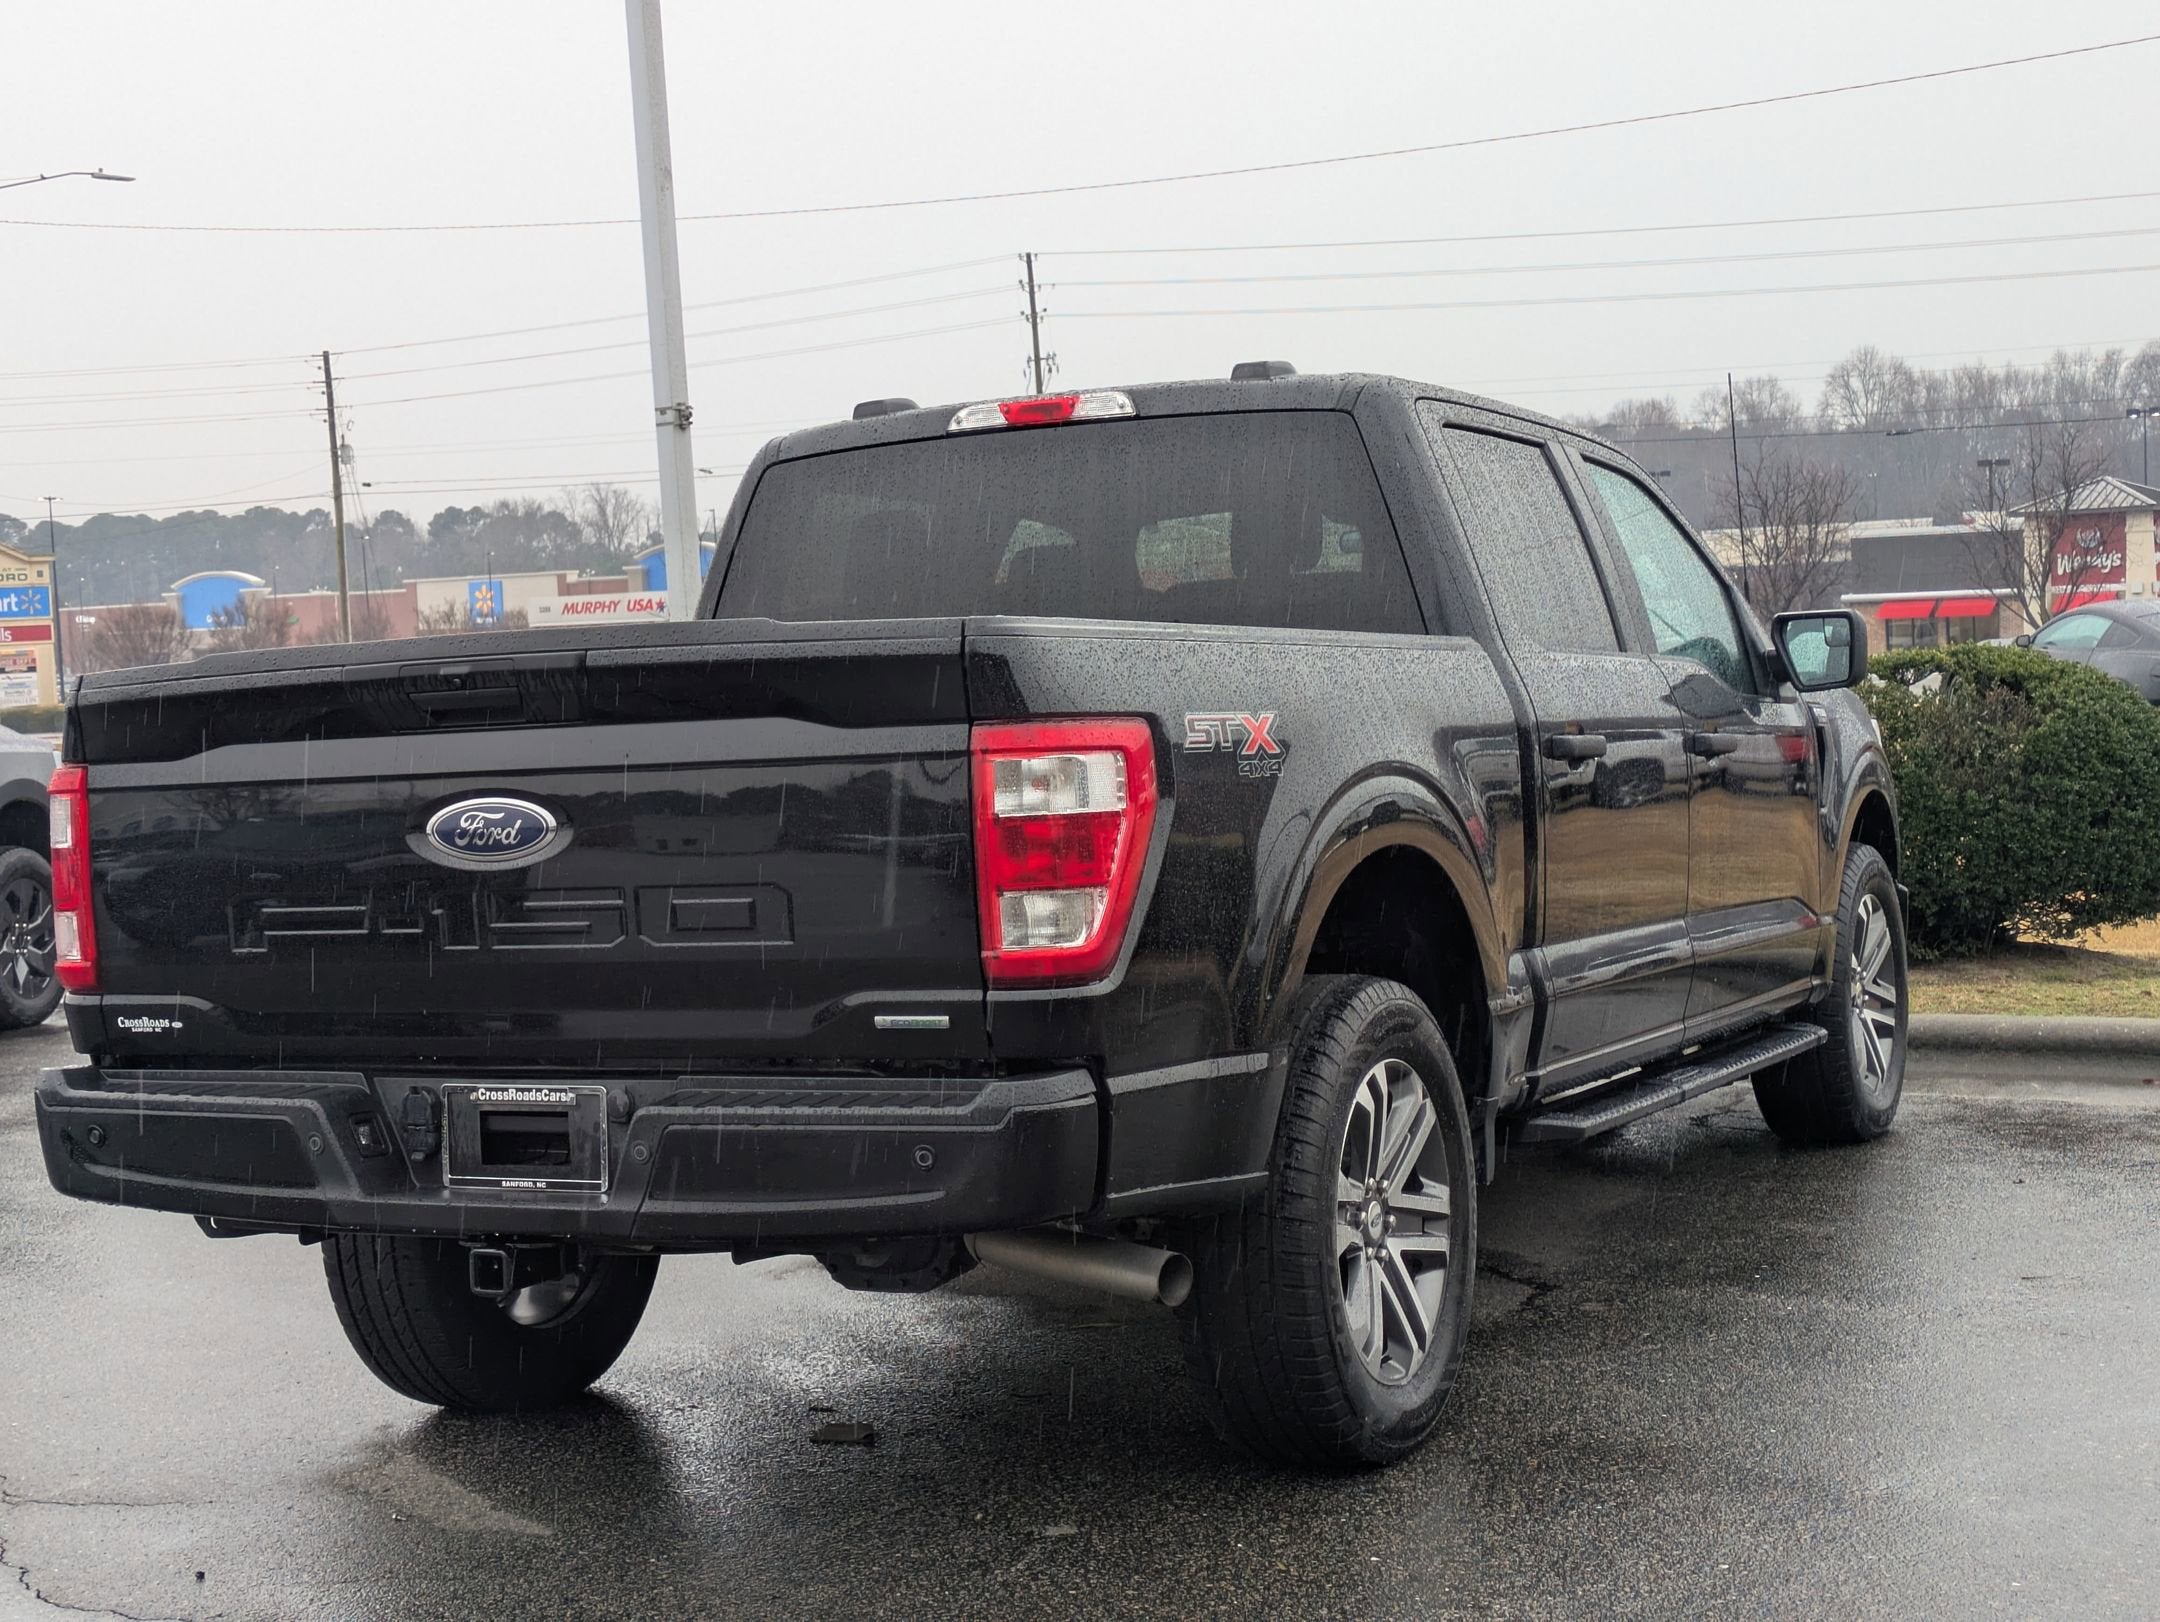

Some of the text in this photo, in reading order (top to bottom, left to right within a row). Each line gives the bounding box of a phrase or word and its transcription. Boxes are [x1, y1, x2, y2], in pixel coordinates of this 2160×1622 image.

[0, 592, 19, 612] rt
[561, 600, 621, 615] MURPHY
[626, 599, 654, 612] USA
[1184, 711, 1286, 762] STX
[454, 811, 522, 846] Ford
[228, 886, 795, 952] F-150
[536, 1181, 547, 1189] NC
